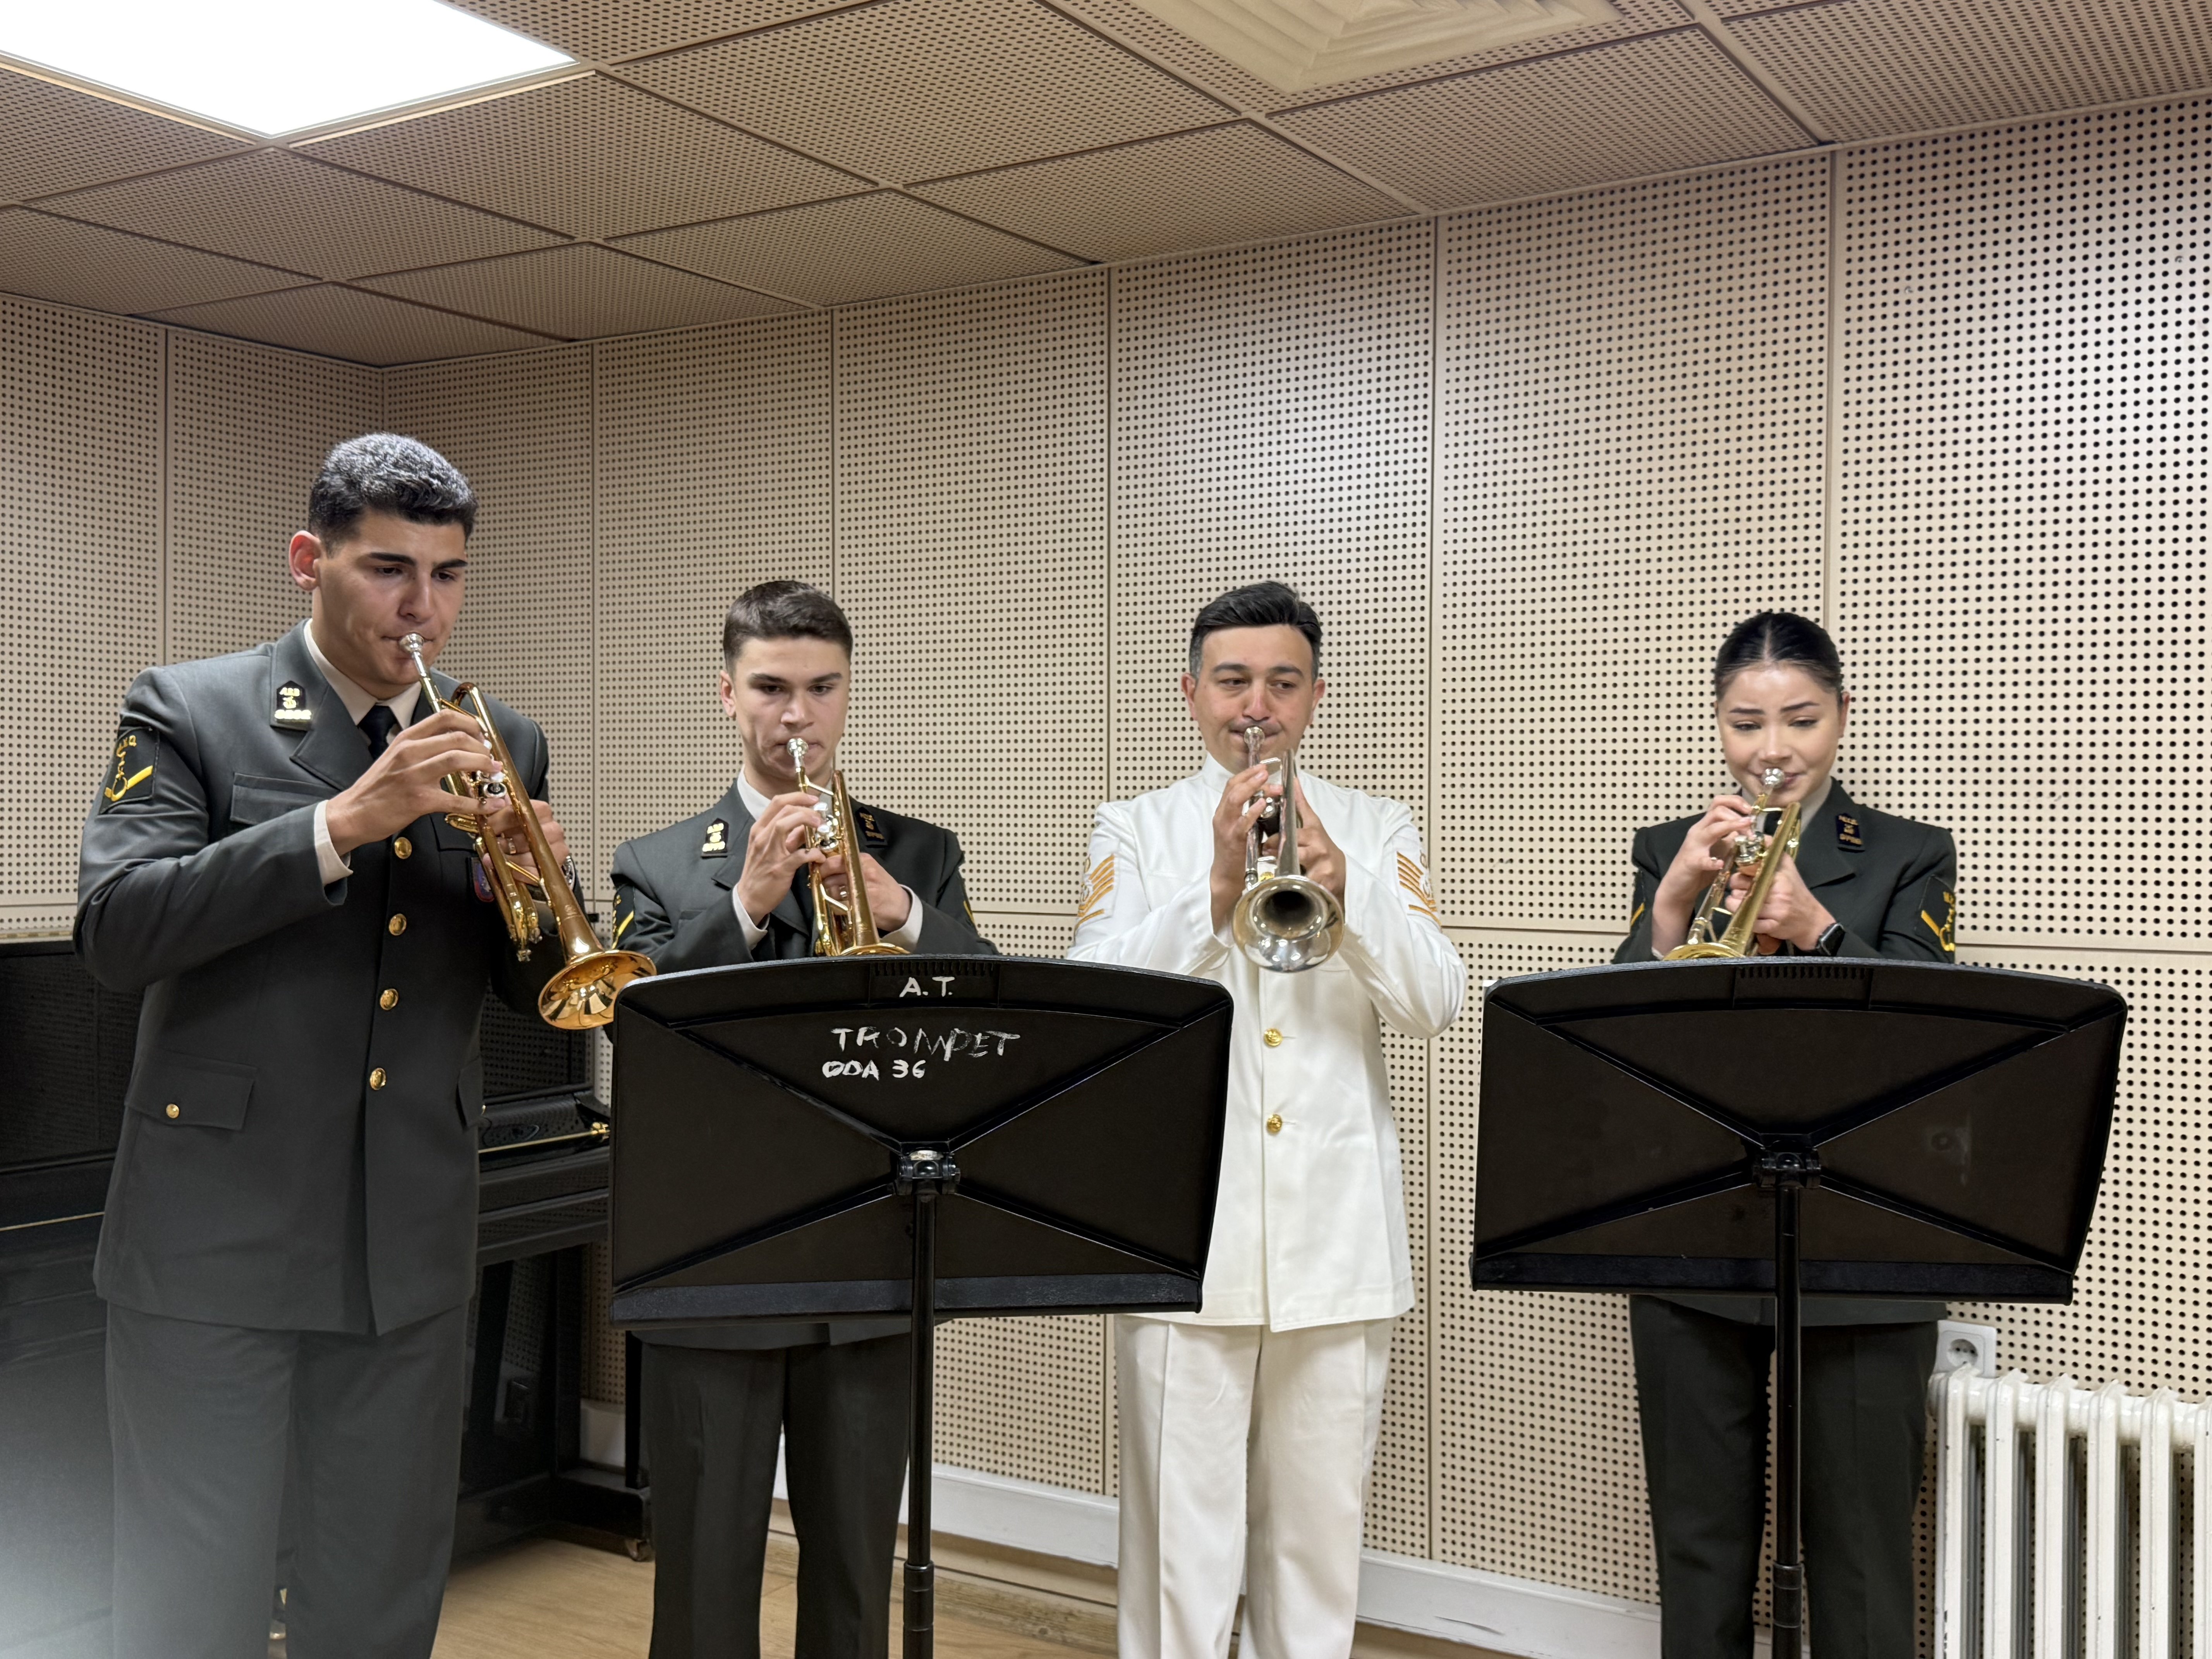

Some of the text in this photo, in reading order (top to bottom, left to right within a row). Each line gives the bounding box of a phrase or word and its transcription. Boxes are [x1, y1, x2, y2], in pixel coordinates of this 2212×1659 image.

[831, 1026, 1020, 1061] TROMPET
[822, 1059, 926, 1081] ODA 36
